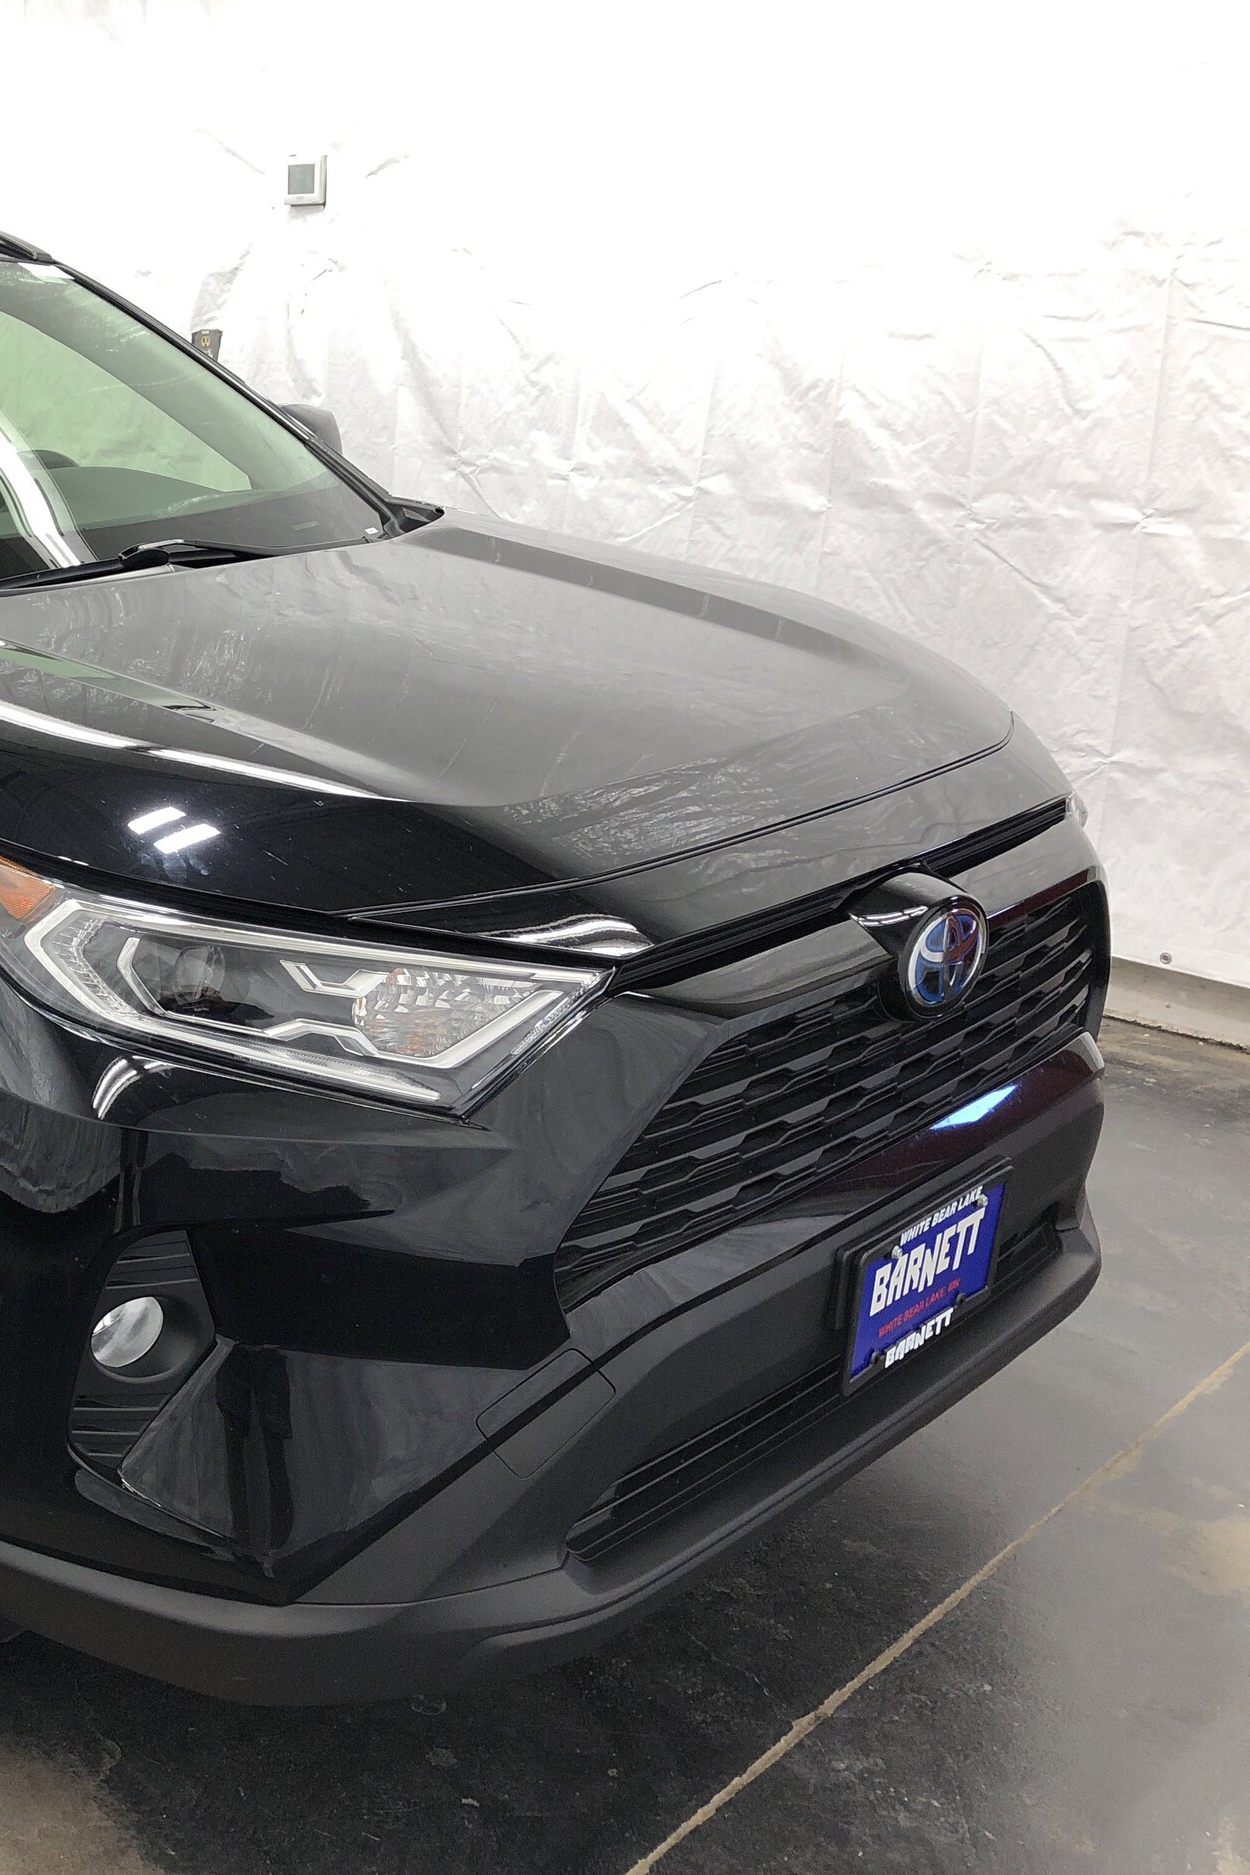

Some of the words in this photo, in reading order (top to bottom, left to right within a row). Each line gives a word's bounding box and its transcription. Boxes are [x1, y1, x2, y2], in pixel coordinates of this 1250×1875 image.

[900, 1216, 932, 1247] WHITE
[931, 1201, 958, 1228] BEAR
[957, 1185, 983, 1212] LAKE
[869, 1206, 986, 1317] BARNETT
[885, 1308, 954, 1369] BARNETT
